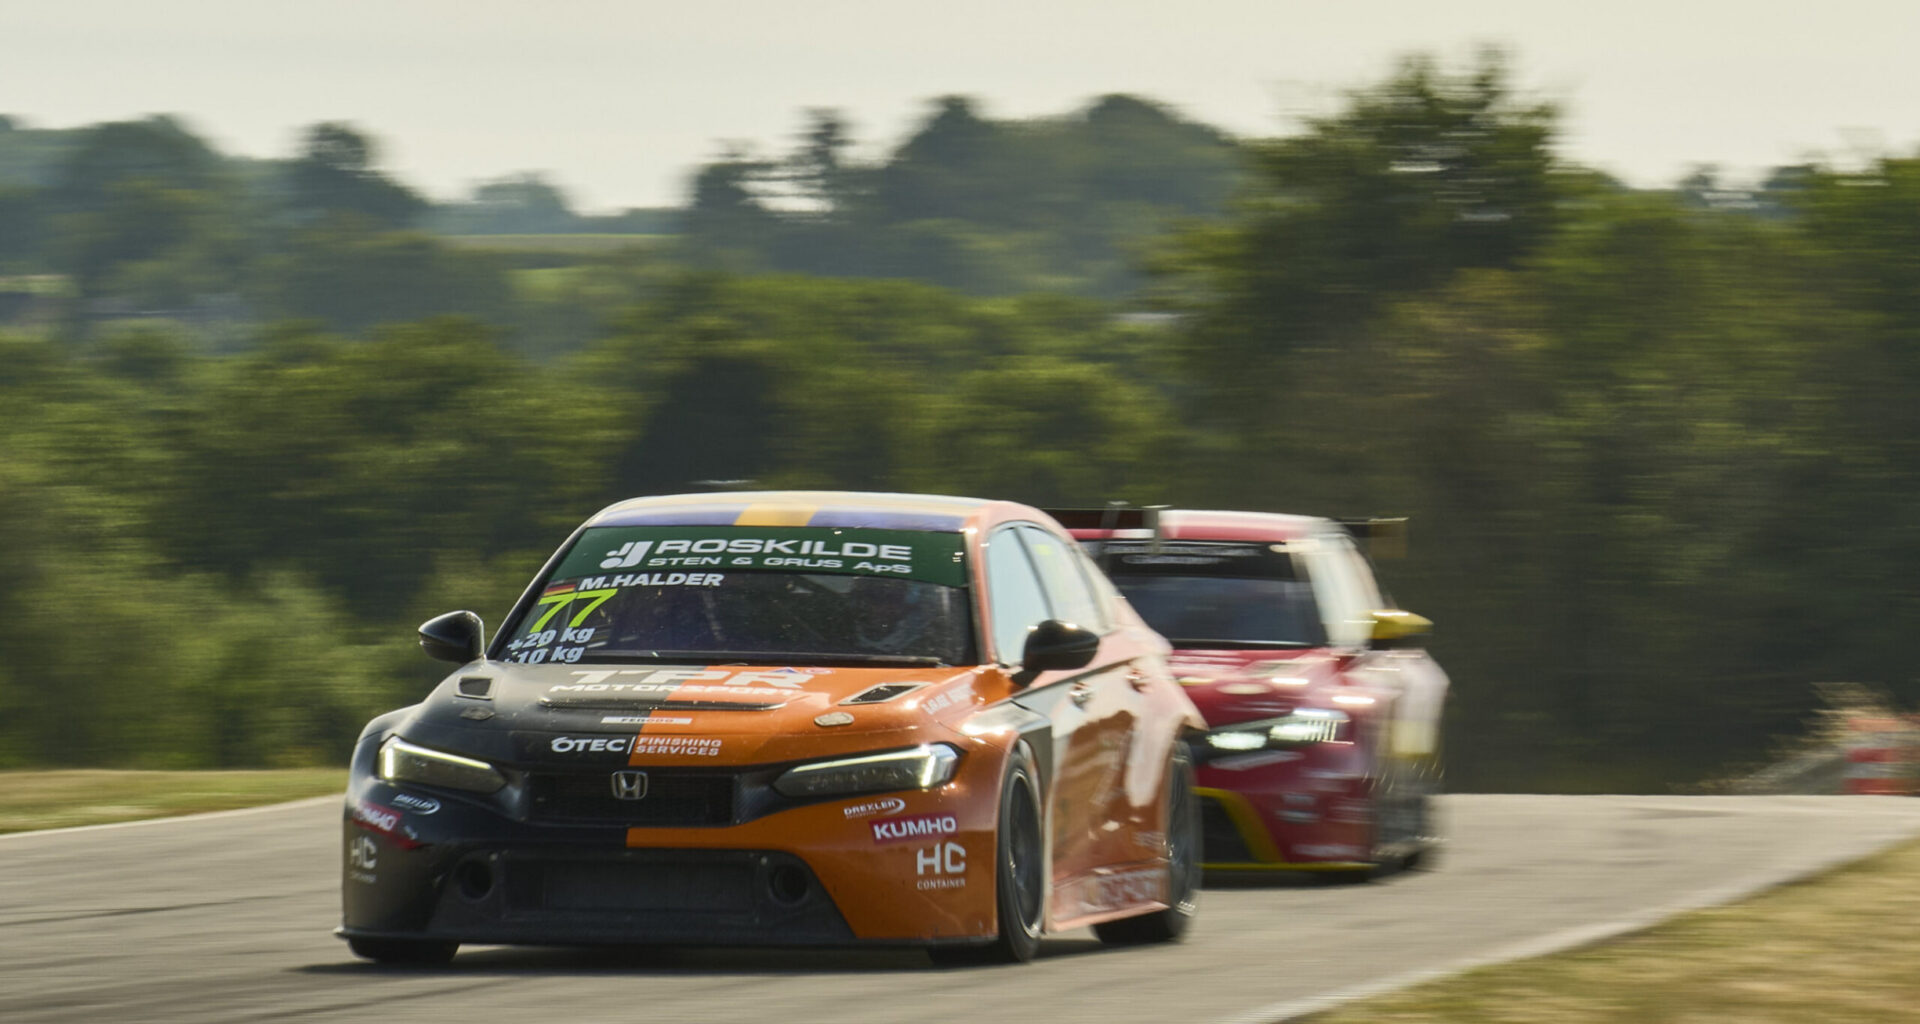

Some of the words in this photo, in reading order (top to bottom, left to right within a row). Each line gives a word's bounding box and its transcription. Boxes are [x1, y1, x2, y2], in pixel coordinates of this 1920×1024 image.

[654, 538, 912, 561] ROSKILDE
[648, 556, 722, 567] STEN
[731, 556, 753, 565] &
[763, 557, 843, 568] GRUS
[853, 560, 913, 573] ApS
[578, 573, 724, 590] M.HALDER
[529, 588, 618, 633] 77
[507, 629, 557, 650] +20
[560, 627, 596, 644] kg
[551, 646, 585, 663] kg
[570, 670, 815, 689] TPR
[550, 684, 800, 697] MOTORSPORT
[636, 745, 720, 757] SERVICES
[638, 737, 722, 748] FINISHING
[843, 800, 896, 816] DREXLER
[873, 816, 957, 840] KUMHO
[916, 841, 966, 875] HC
[917, 878, 966, 890] CONTAINER
